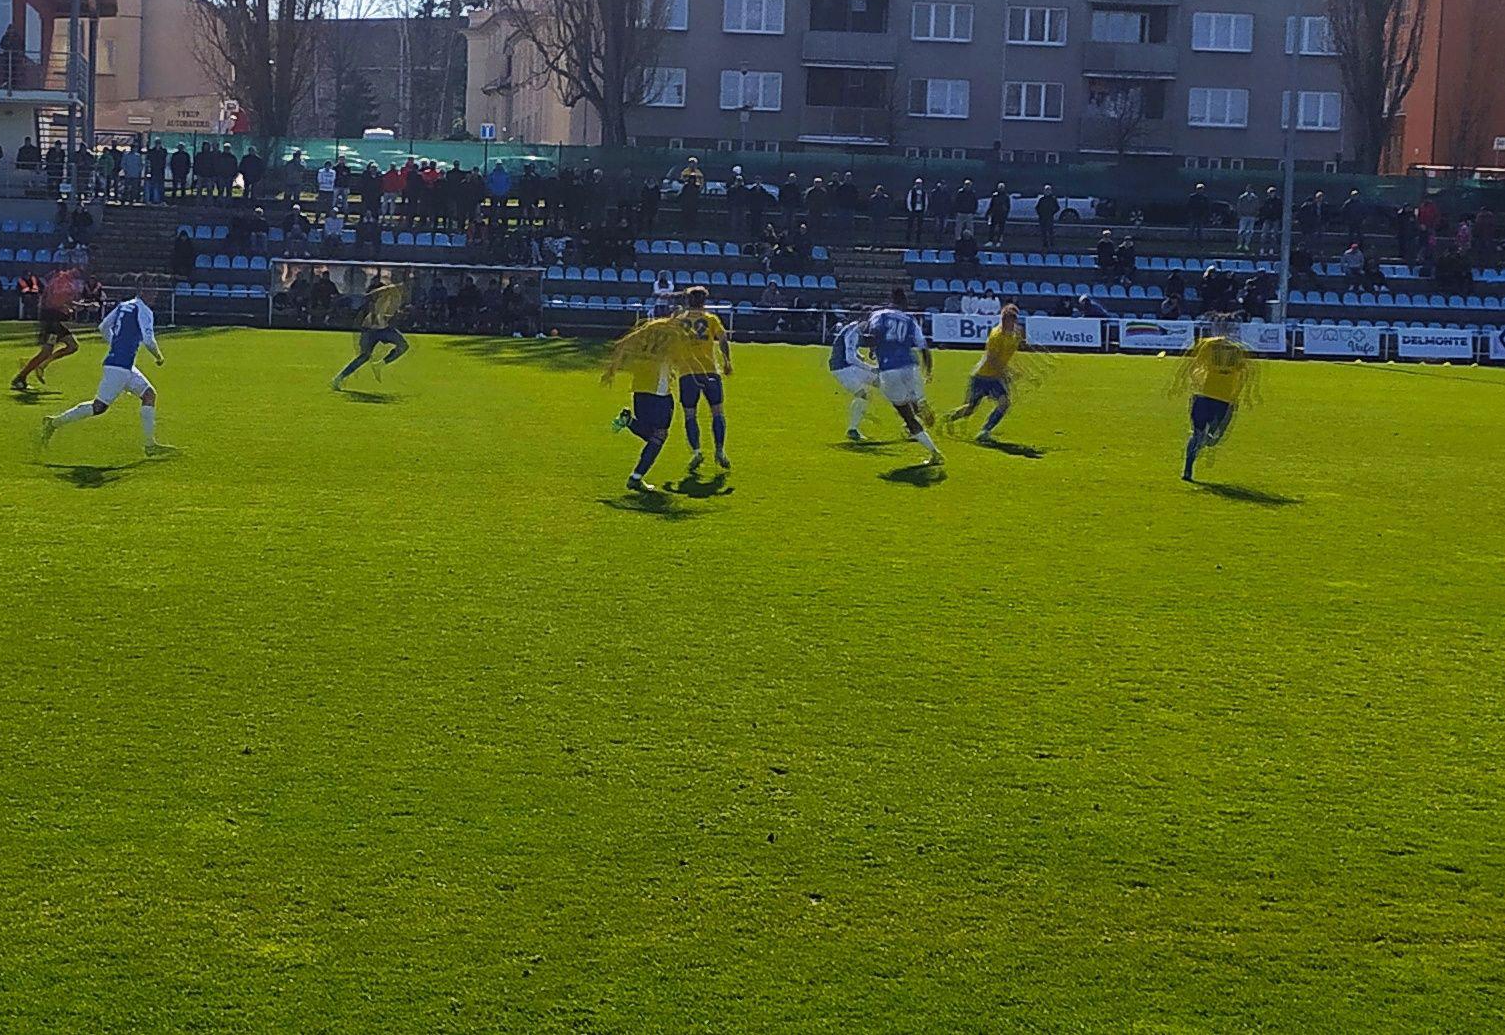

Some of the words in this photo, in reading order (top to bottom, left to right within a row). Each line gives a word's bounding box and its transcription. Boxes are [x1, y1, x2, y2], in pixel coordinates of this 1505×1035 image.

[885, 319, 908, 342] 20
[960, 319, 993, 338] Bri
[1052, 330, 1094, 343] Waste
[1401, 335, 1468, 346] DELMONTE
